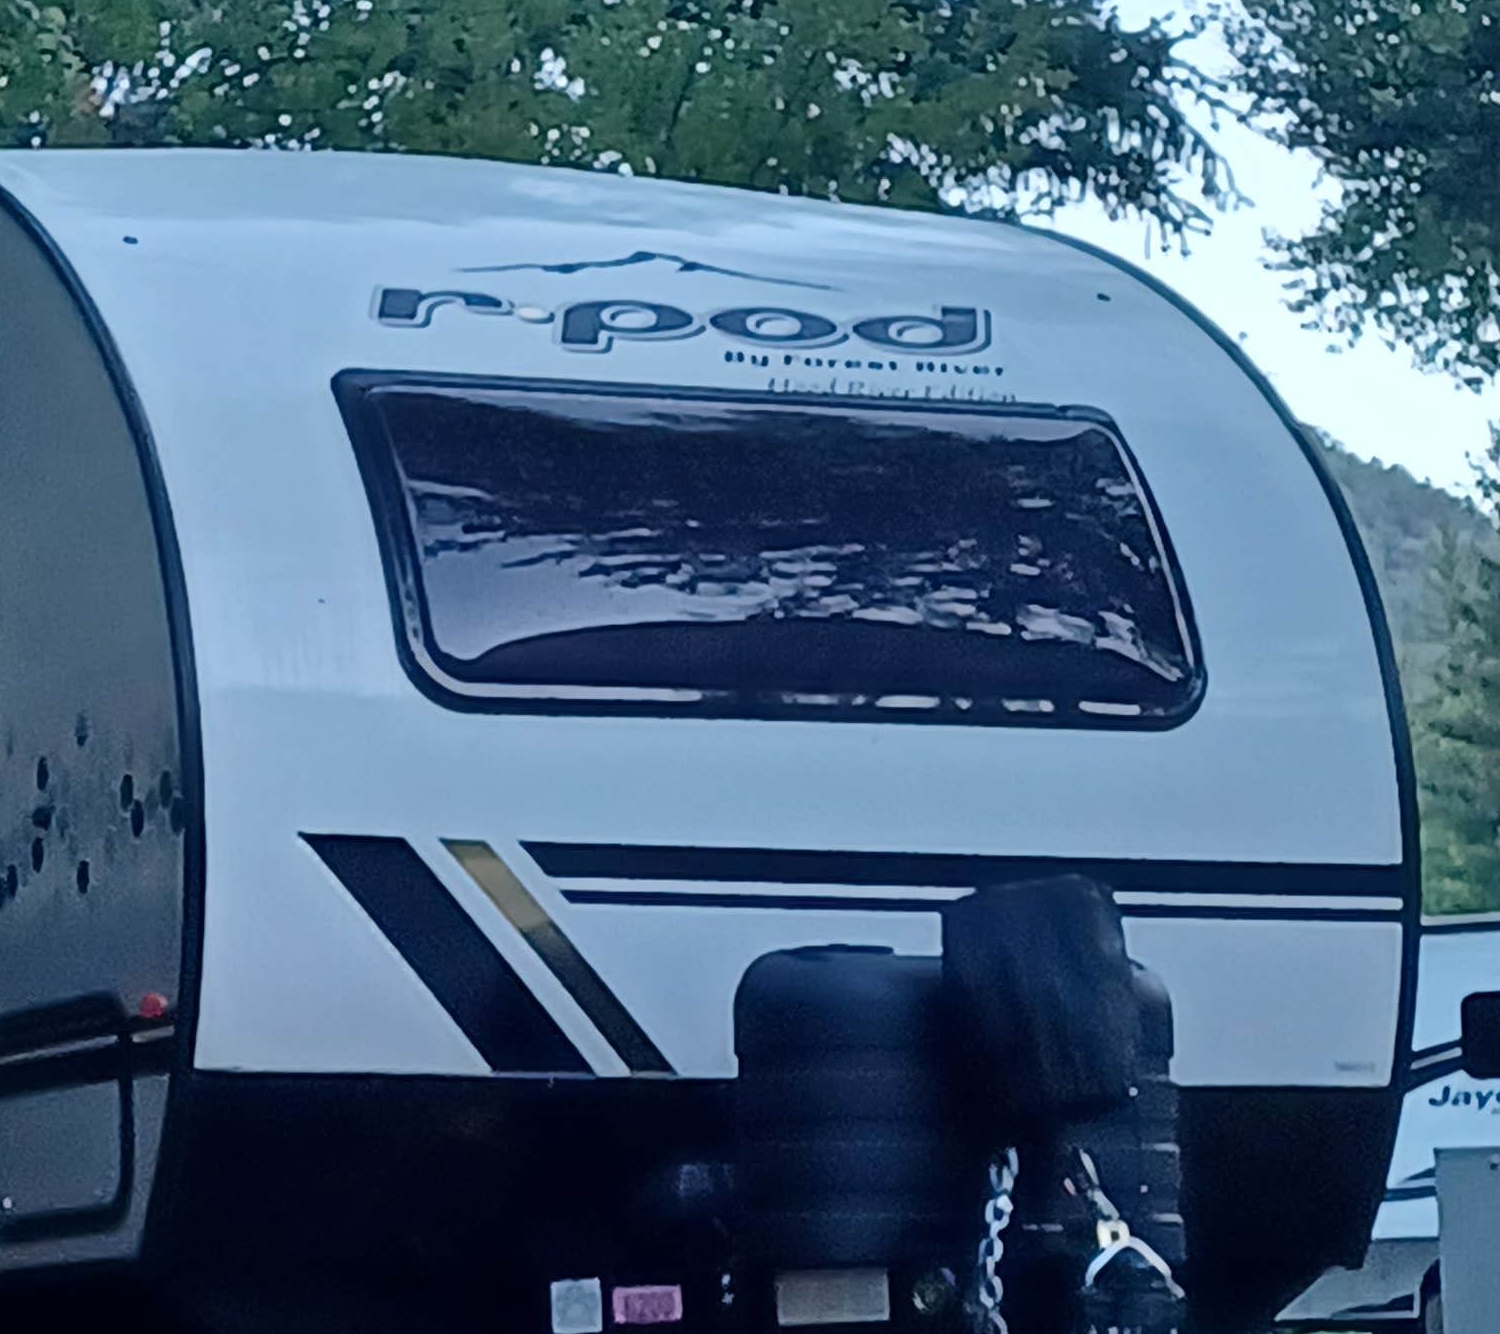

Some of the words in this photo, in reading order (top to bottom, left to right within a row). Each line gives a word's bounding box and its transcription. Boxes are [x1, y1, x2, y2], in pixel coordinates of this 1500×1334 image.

[723, 350, 770, 368] By
[782, 353, 899, 372] Forest
[915, 360, 1005, 378] River
[1428, 1085, 1500, 1111] Jay
